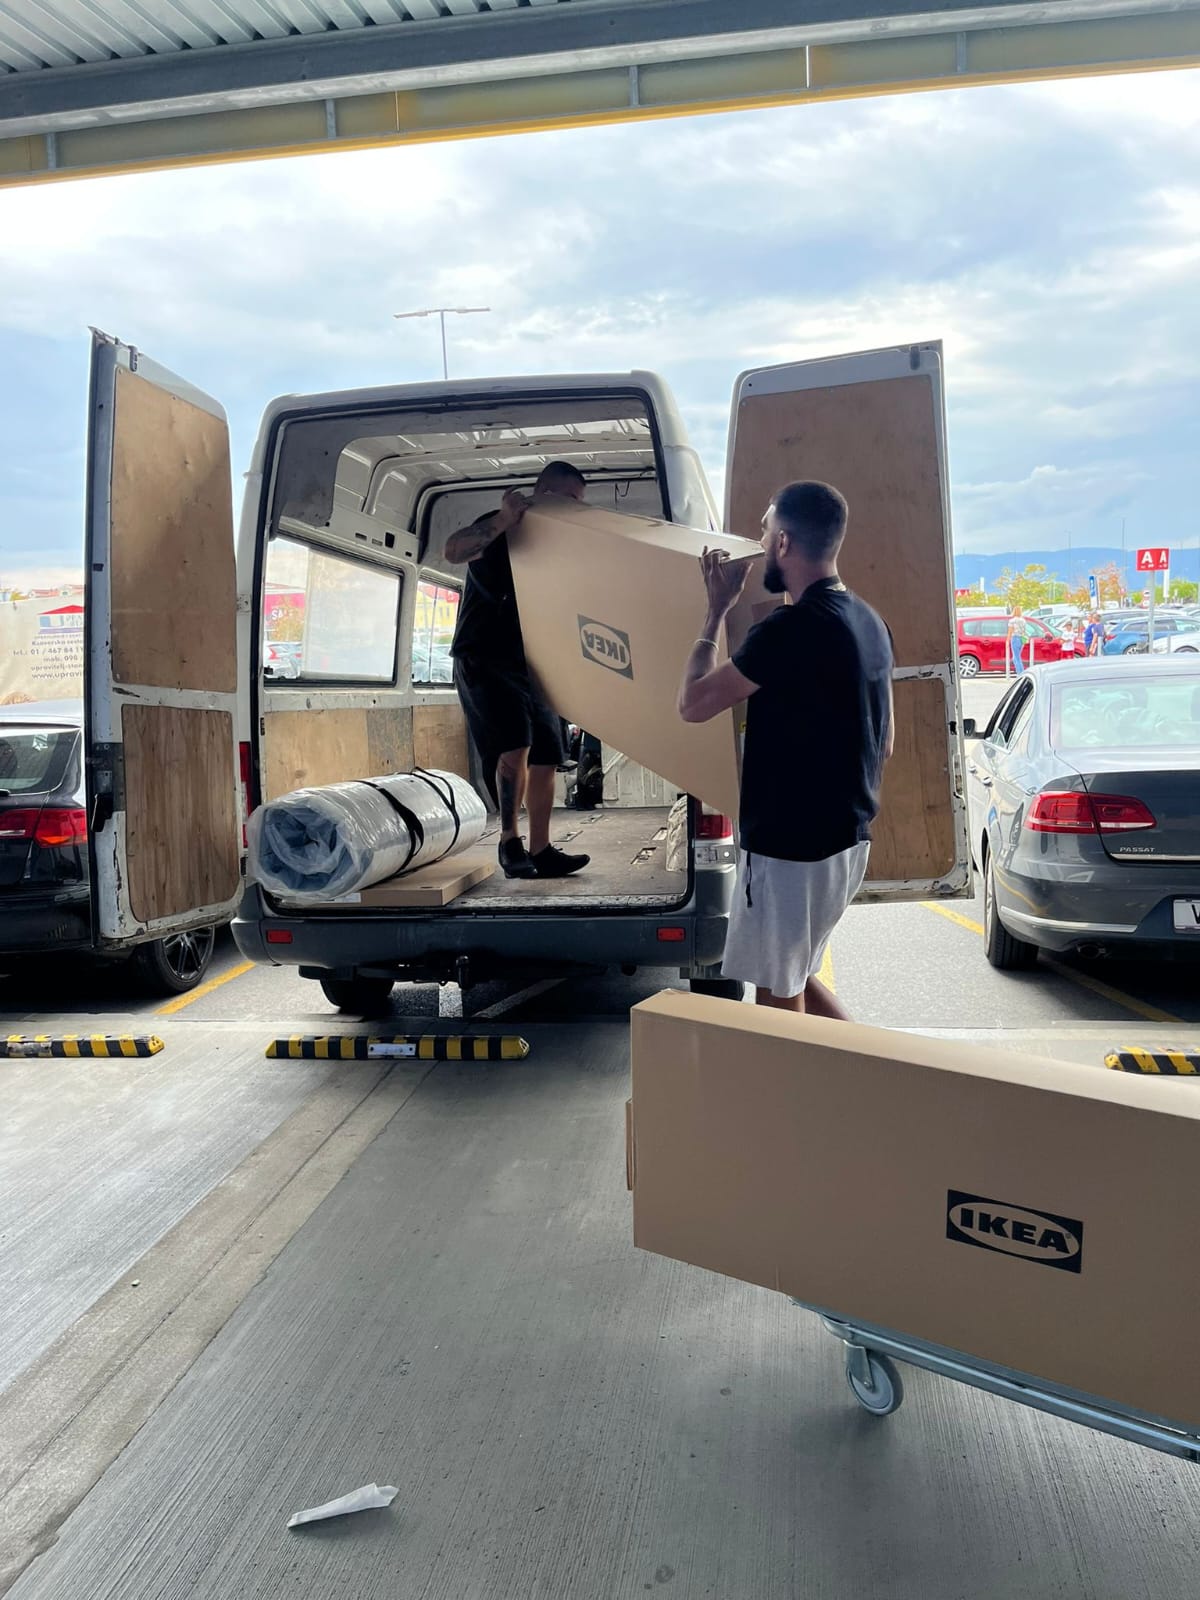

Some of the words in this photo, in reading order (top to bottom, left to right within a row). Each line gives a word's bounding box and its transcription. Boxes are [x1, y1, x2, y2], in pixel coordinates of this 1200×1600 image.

[1141, 551, 1153, 564] A
[583, 629, 626, 664] IKEA
[960, 1207, 1070, 1254] IKEA
